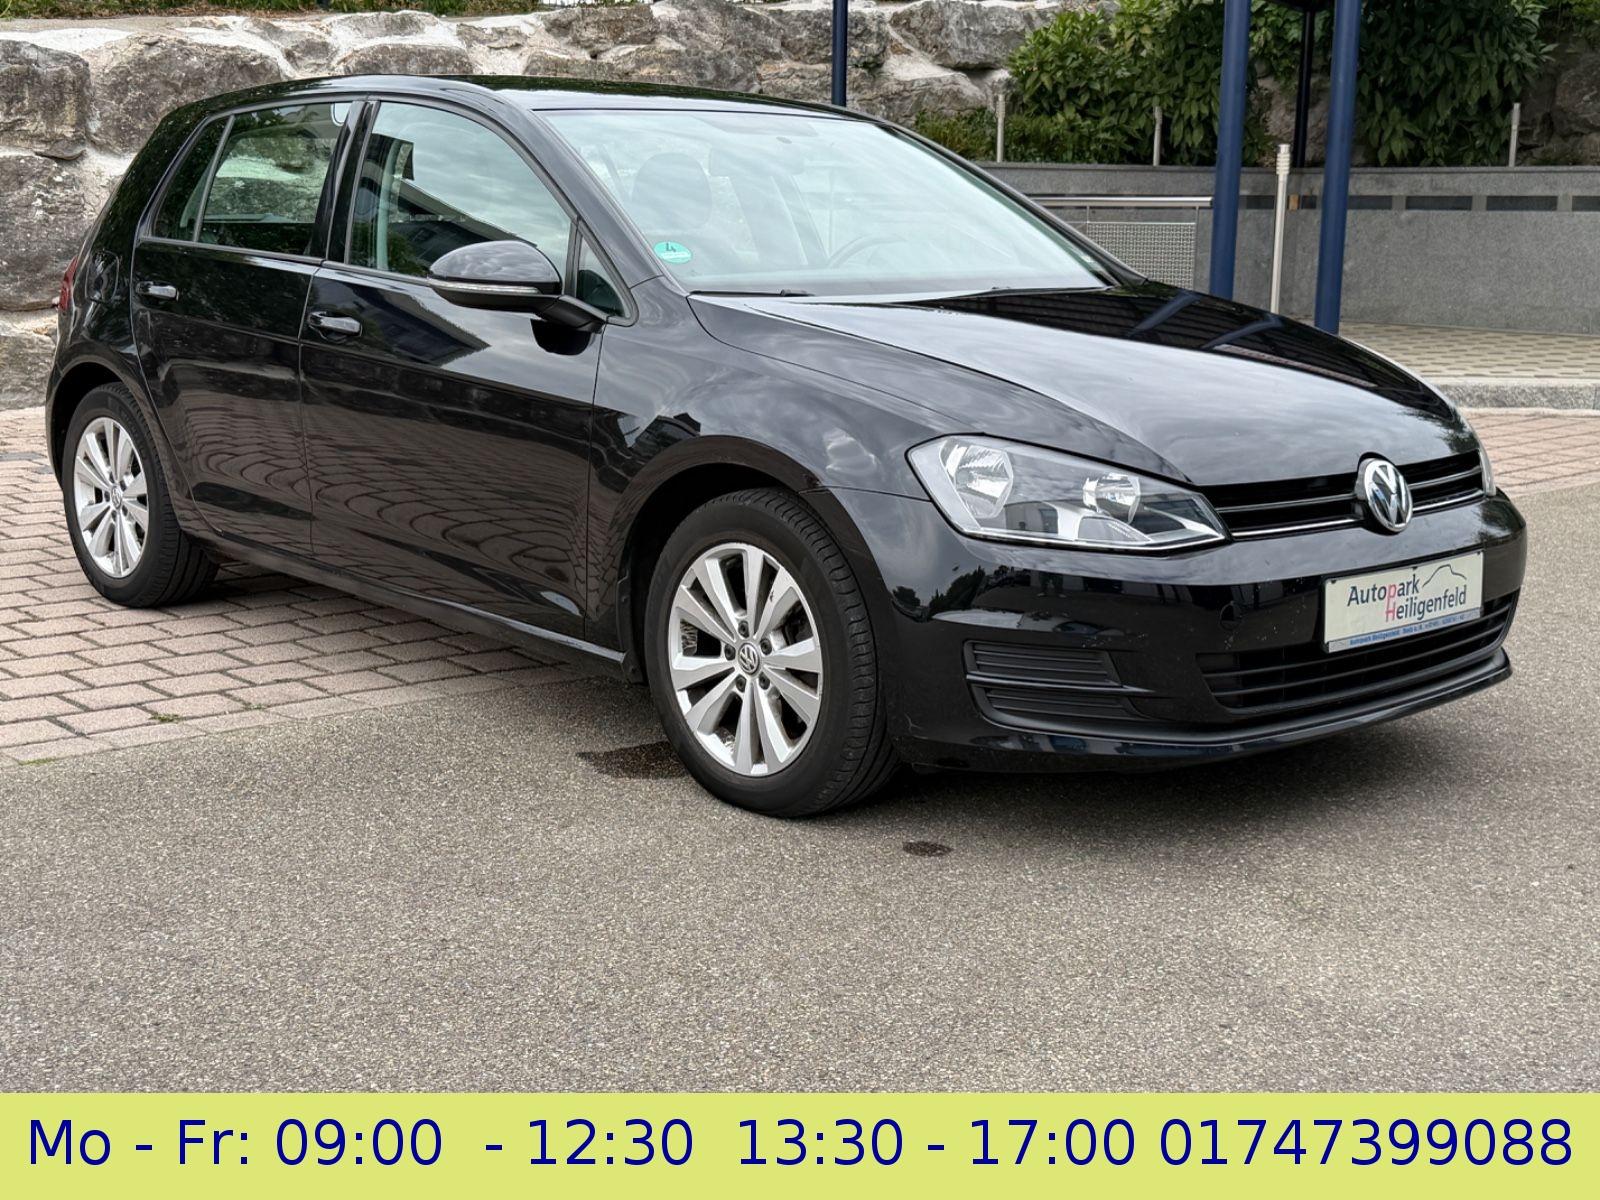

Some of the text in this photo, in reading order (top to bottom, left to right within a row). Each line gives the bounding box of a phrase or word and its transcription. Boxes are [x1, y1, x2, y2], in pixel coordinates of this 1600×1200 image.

[1364, 458, 1413, 533] VW
[1347, 574, 1420, 607] Autopark
[1385, 585, 1467, 622] Heiligenfeld
